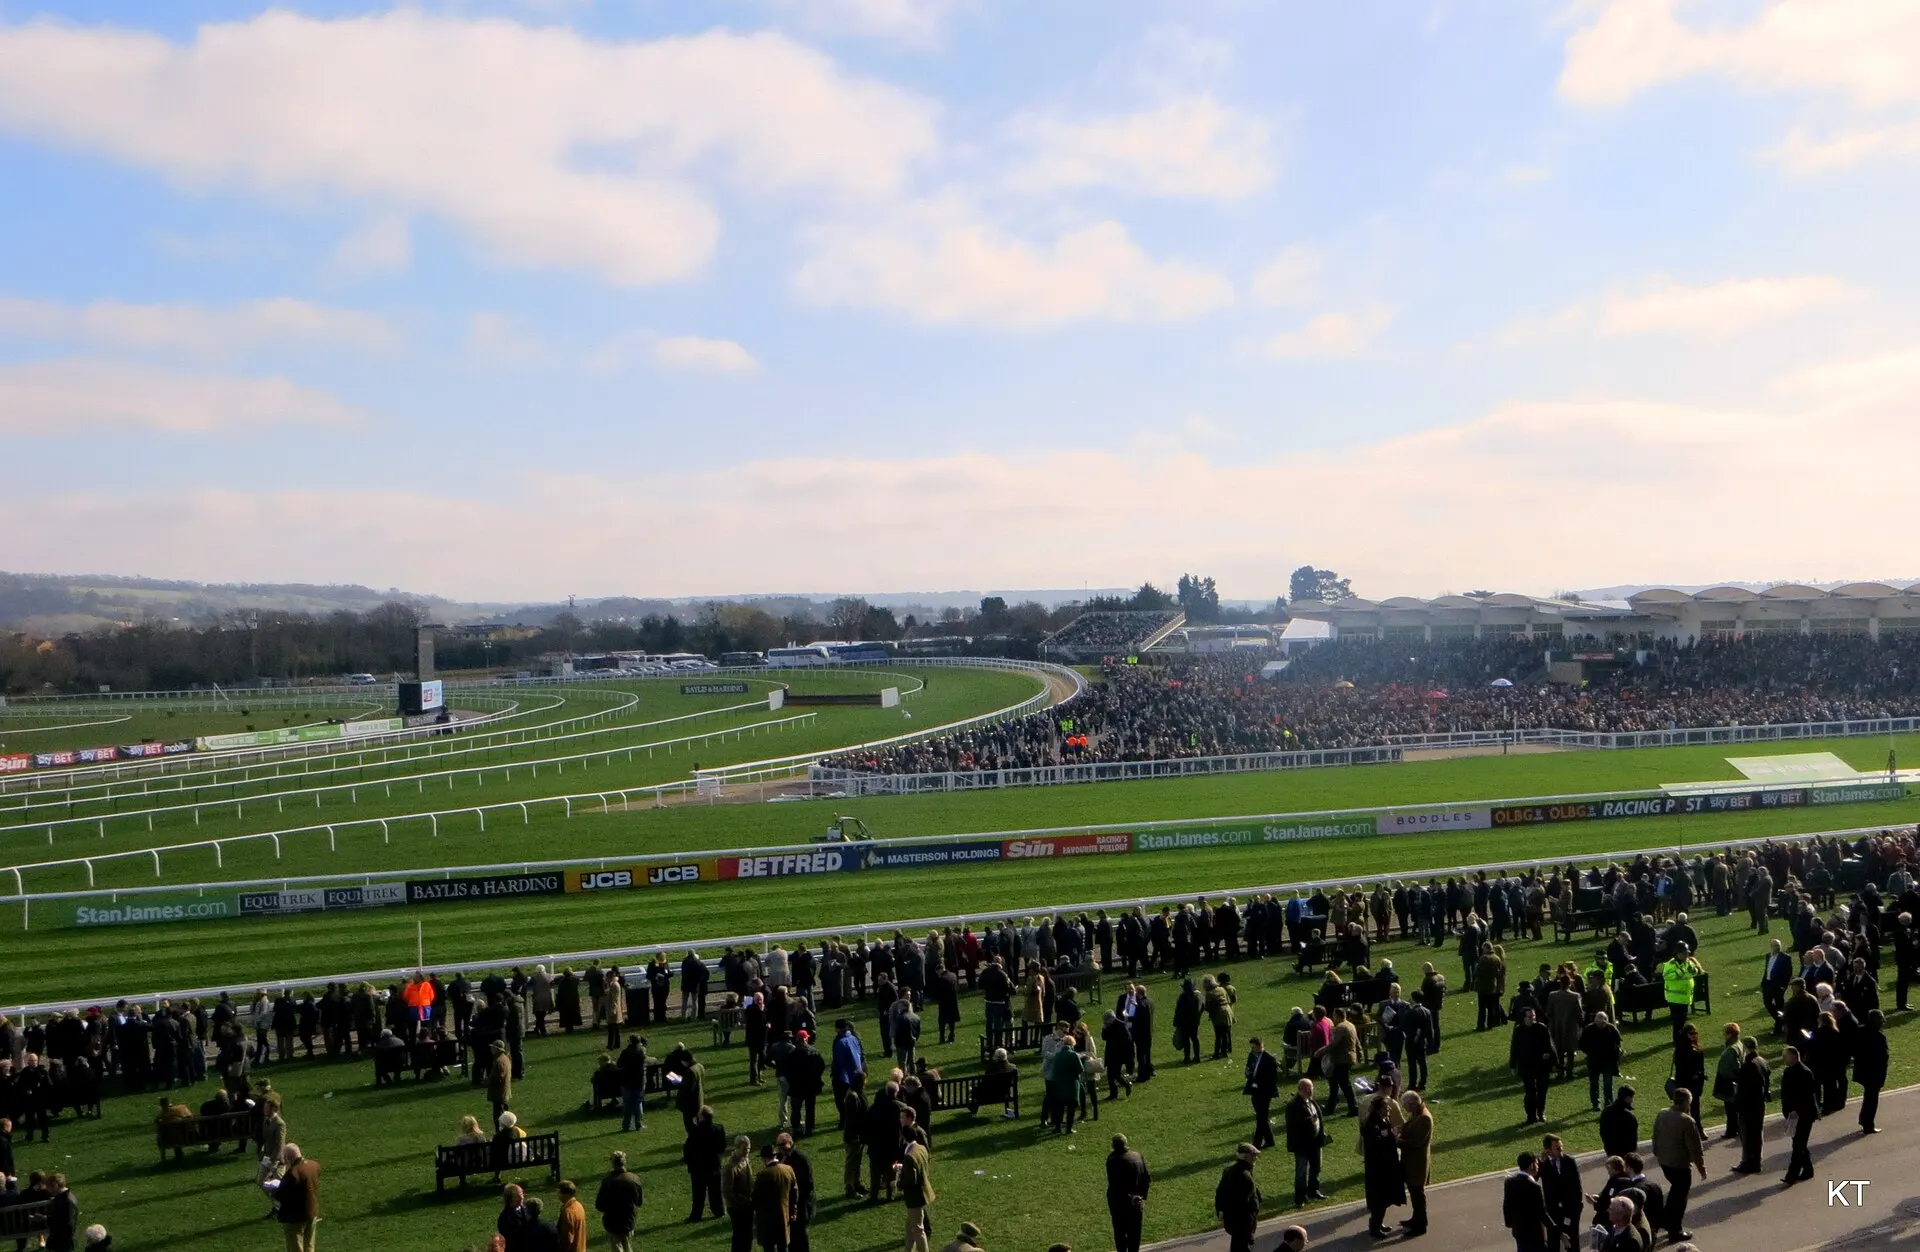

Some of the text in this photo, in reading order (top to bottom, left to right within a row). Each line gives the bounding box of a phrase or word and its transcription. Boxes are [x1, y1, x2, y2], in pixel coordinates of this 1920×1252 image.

[81, 748, 113, 761] sky BET
[145, 744, 161, 754] BET
[54, 752, 72, 763] BET
[1710, 796, 1752, 808] sky BET
[1762, 792, 1801, 804] sky BET
[1812, 788, 1900, 803] StanJames.com
[1603, 800, 1660, 816] RACING
[1396, 812, 1472, 825] BOODLES
[1263, 822, 1371, 840] StanJames.com
[1139, 830, 1252, 849] StanJames.com
[888, 851, 948, 864] MASTERSON
[951, 848, 1000, 860] HOLDINGS
[1007, 841, 1055, 858] Sun
[738, 852, 843, 877] BETFRED
[581, 871, 632, 889] JCB
[650, 866, 699, 883] JCB
[413, 876, 558, 899] BAYLIS & HARDING
[76, 900, 228, 924] StanJames.com
